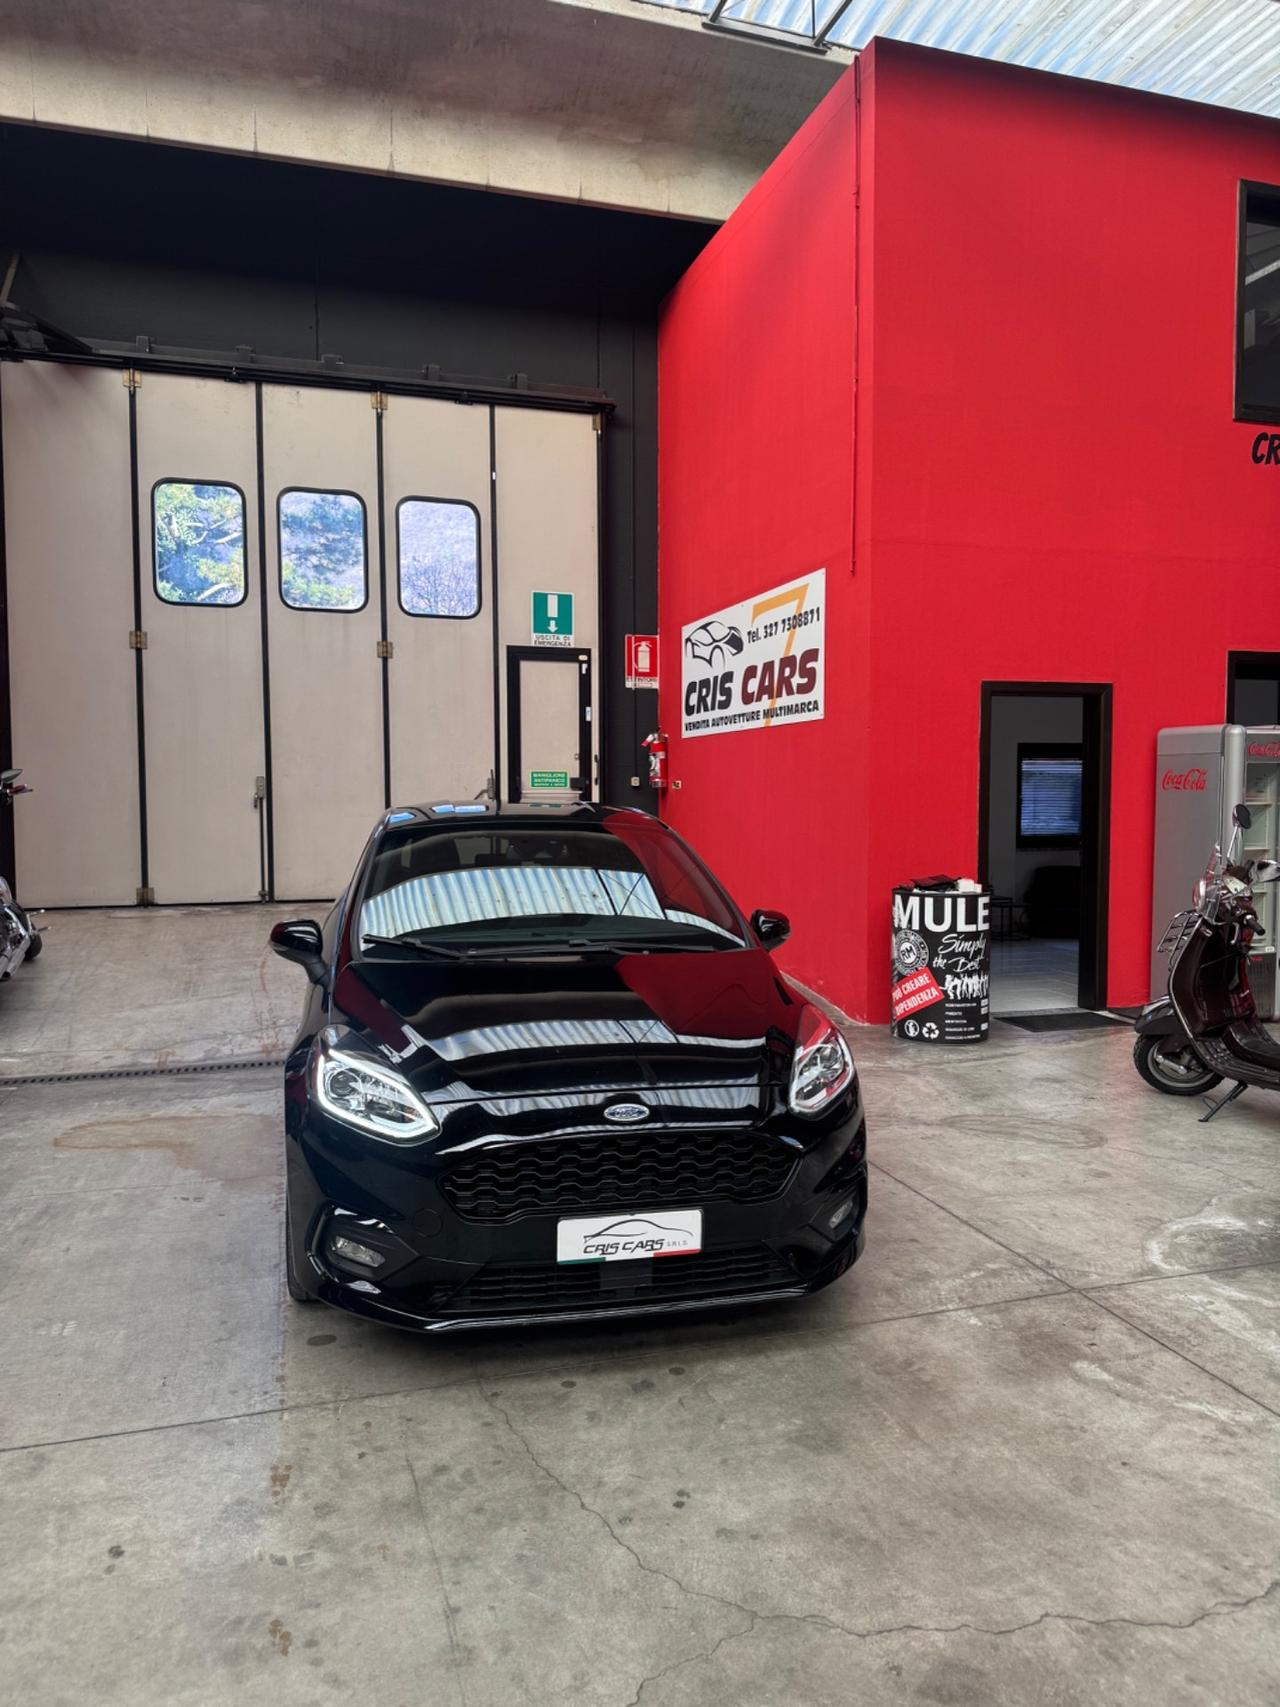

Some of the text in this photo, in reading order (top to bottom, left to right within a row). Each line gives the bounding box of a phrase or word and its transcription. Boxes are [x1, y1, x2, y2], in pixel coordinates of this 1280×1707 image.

[747, 606, 820, 644] Tel. 327 7308871
[684, 648, 820, 717] CRIS CARS
[684, 699, 820, 732] VENDITA AUTOVETTURE MULTIMARCA
[892, 894, 990, 933] MULE
[937, 931, 987, 960] Simply
[932, 953, 947, 970] the
[902, 973, 932, 995] CREARE
[583, 1242, 620, 1255] CRIS
[622, 1238, 665, 1253] CARS
